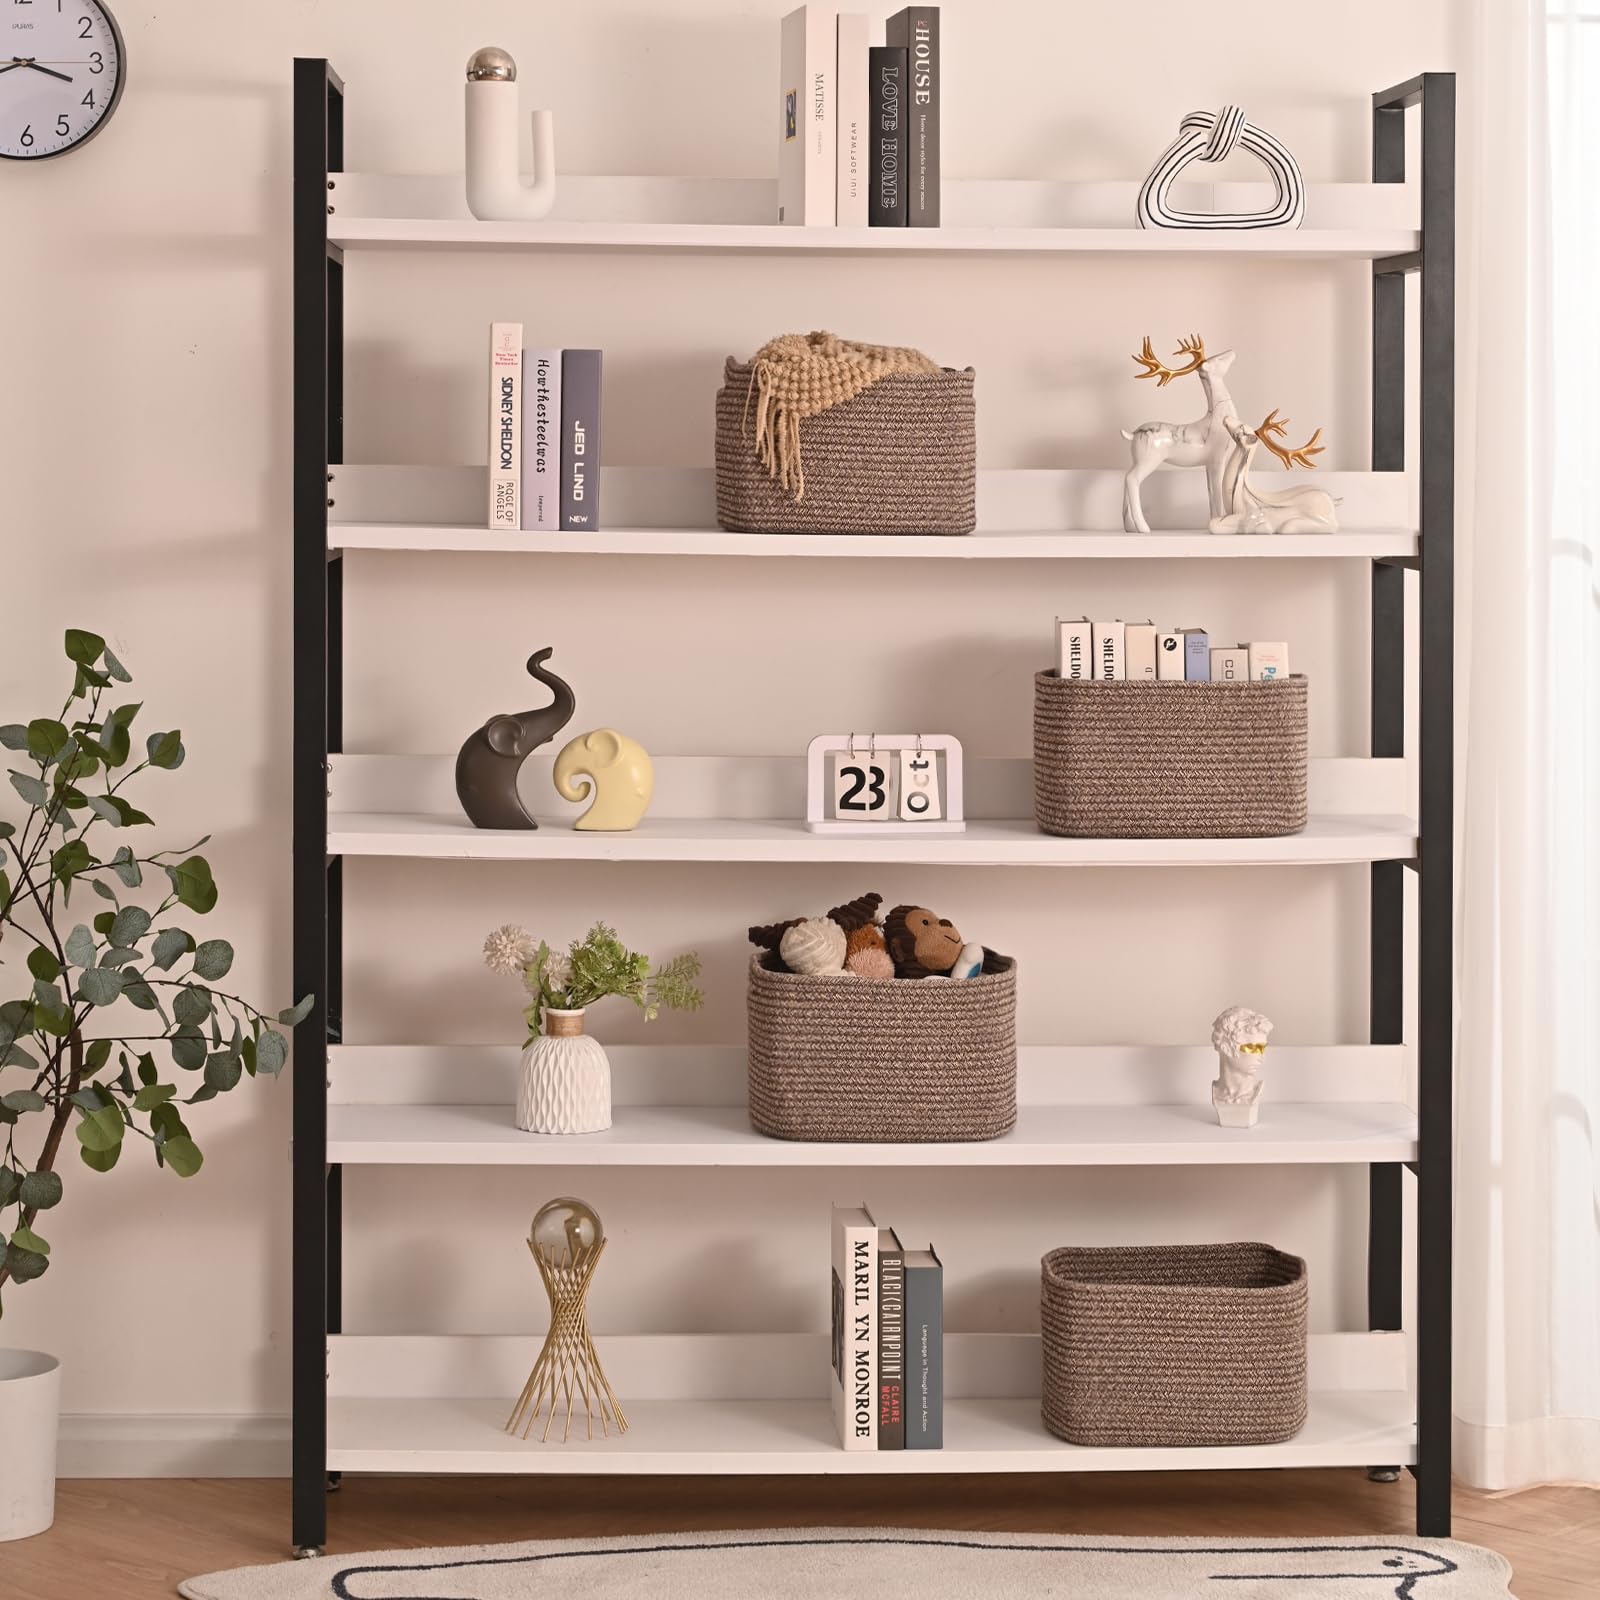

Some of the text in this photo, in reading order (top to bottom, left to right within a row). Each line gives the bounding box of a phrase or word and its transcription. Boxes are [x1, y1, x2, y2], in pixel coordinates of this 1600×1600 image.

[78, 17, 93, 38] 2
[89, 52, 104, 74] 3
[915, 28, 930, 105] HOUSE
[81, 88, 95, 109] 4
[815, 73, 824, 121] MATISSE
[20, 125, 34, 147] 6
[55, 114, 70, 136] 5
[881, 67, 899, 208] LOVE HOME
[500, 377, 513, 470] SIDNEY SHELDON
[536, 359, 550, 474] Howthesteelwas
[573, 420, 585, 501] JED LIND
[496, 484, 504, 520] ANGELS
[505, 509, 514, 522] OF
[569, 515, 588, 523] NEW
[839, 766, 886, 811] 23
[907, 760, 930, 813] Oct
[854, 1241, 870, 1438] MARIL YN MONROE
[921, 1324, 929, 1357] Language
[921, 1367, 929, 1395] Thought
[881, 1386, 890, 1426] MCFALL
[891, 1385, 900, 1424] CLAIRE
